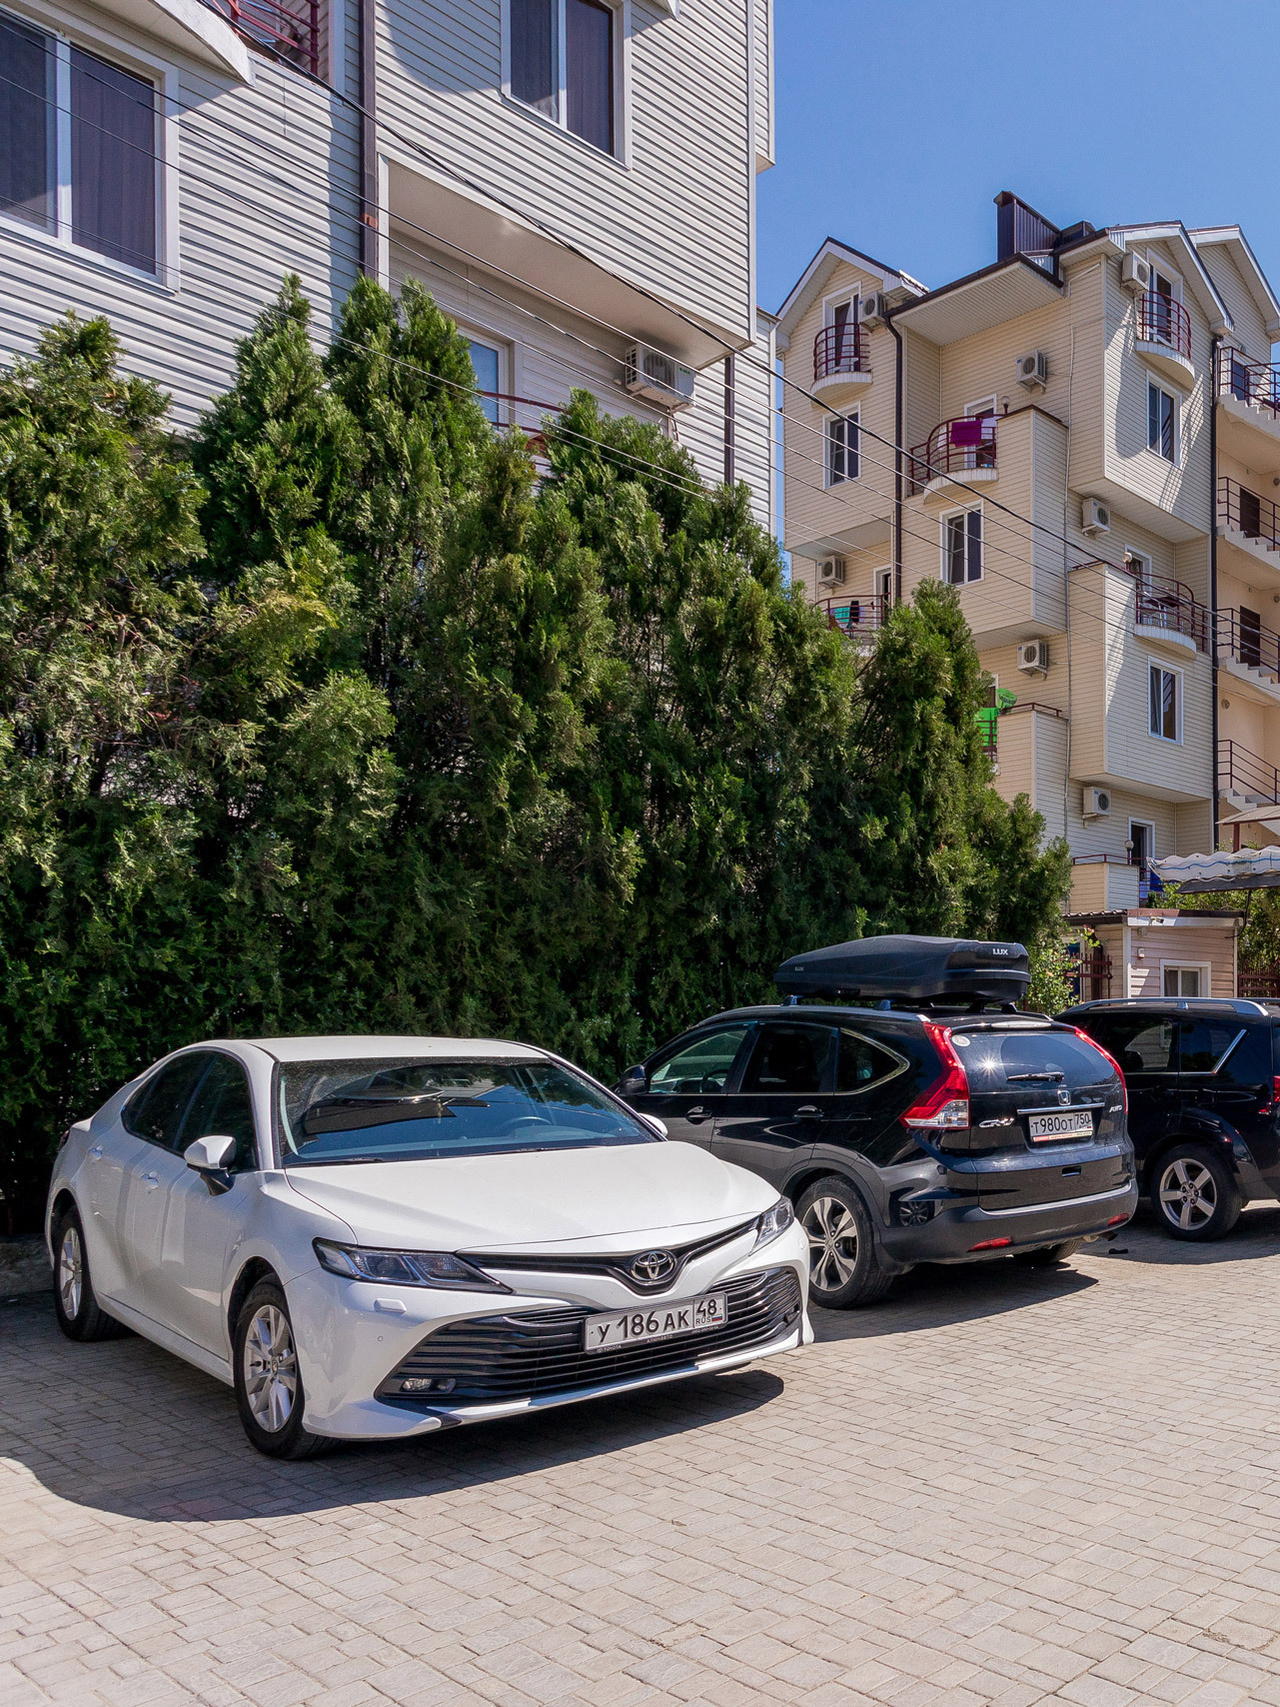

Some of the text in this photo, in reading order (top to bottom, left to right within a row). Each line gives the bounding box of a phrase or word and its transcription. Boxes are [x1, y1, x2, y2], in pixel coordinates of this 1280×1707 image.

[1074, 1113, 1090, 1126] 750
[696, 1299, 718, 1317] 48
[695, 1316, 711, 1325] RUS
